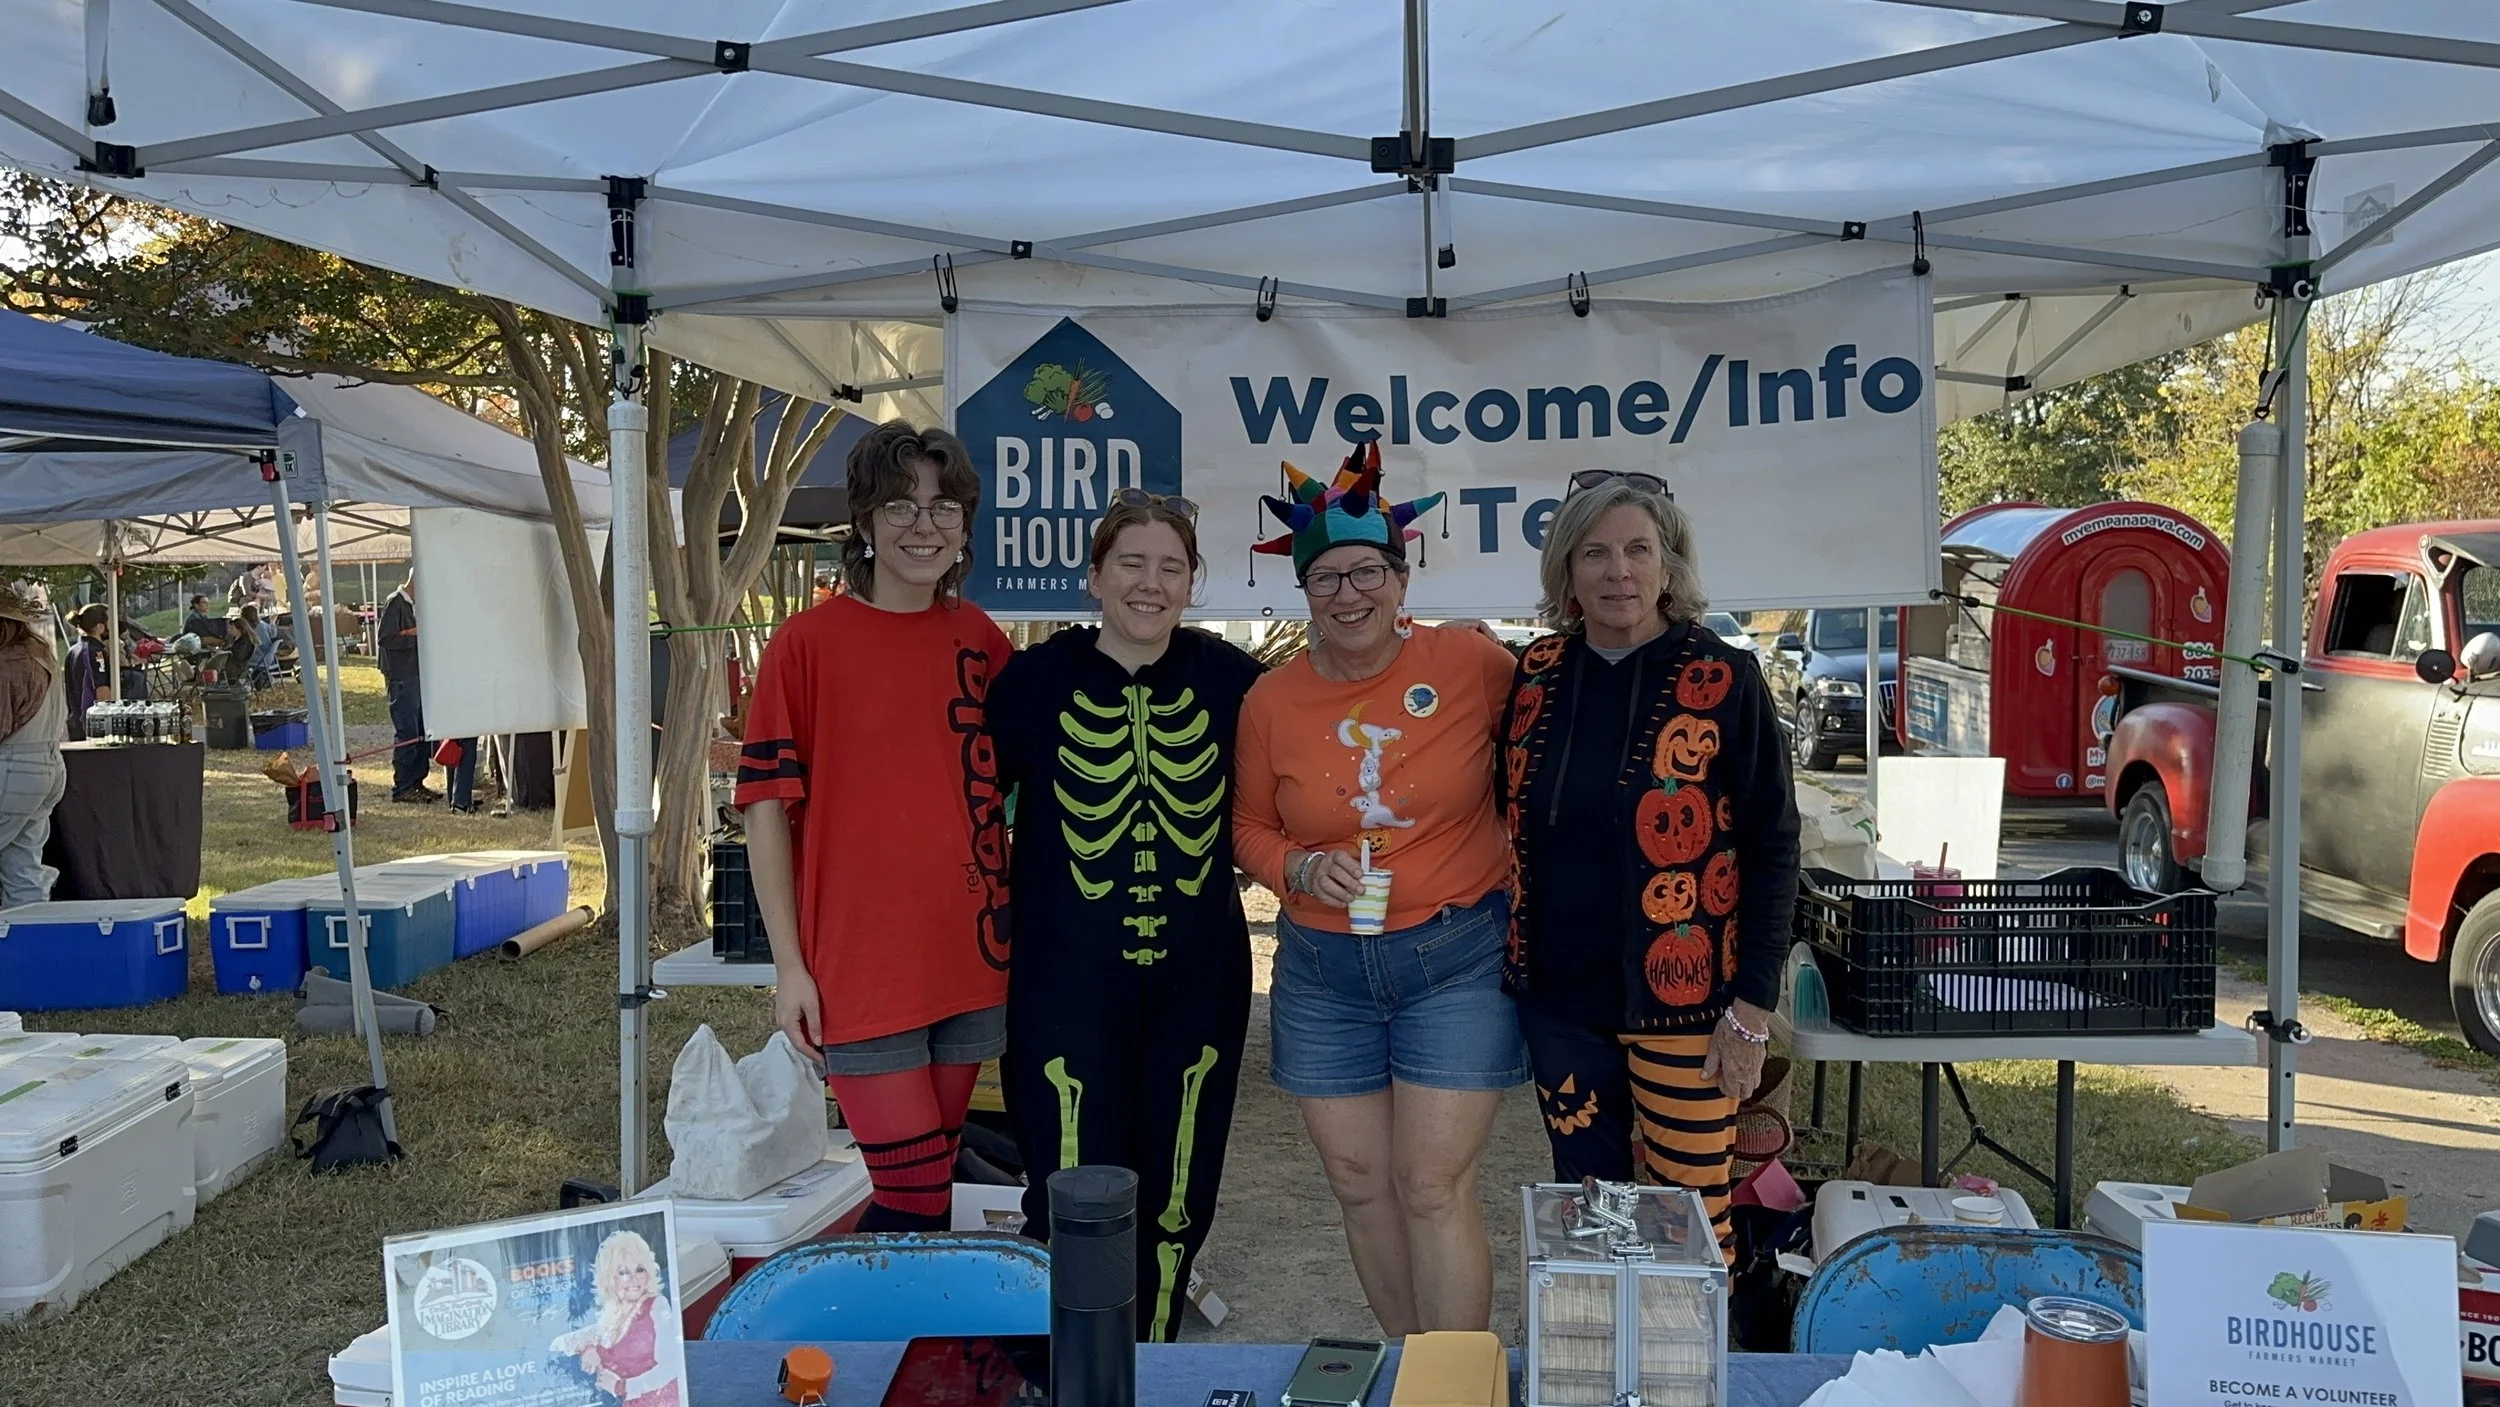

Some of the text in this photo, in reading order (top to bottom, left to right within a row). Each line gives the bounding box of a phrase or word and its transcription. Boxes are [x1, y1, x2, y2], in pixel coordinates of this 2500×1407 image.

[1228, 343, 1924, 446] Welcome/Info
[995, 436, 1142, 510] BIRD
[995, 516, 1103, 569] HOU
[996, 577, 1068, 591] FARMERS
[1649, 948, 1711, 992] HALLOWEEN
[2291, 1211, 2329, 1226] RECIPE
[434, 1318, 481, 1338] LIBRARY
[2227, 1316, 2377, 1355] BIRDHOUSE
[2249, 1351, 2357, 1367] FARMERS MARKET
[419, 1361, 537, 1395] INSPIRE A LOVE
[421, 1396, 443, 1407] OF
[445, 1379, 516, 1403] READING
[2209, 1380, 2397, 1407] BECOME A VOLUNTEER
